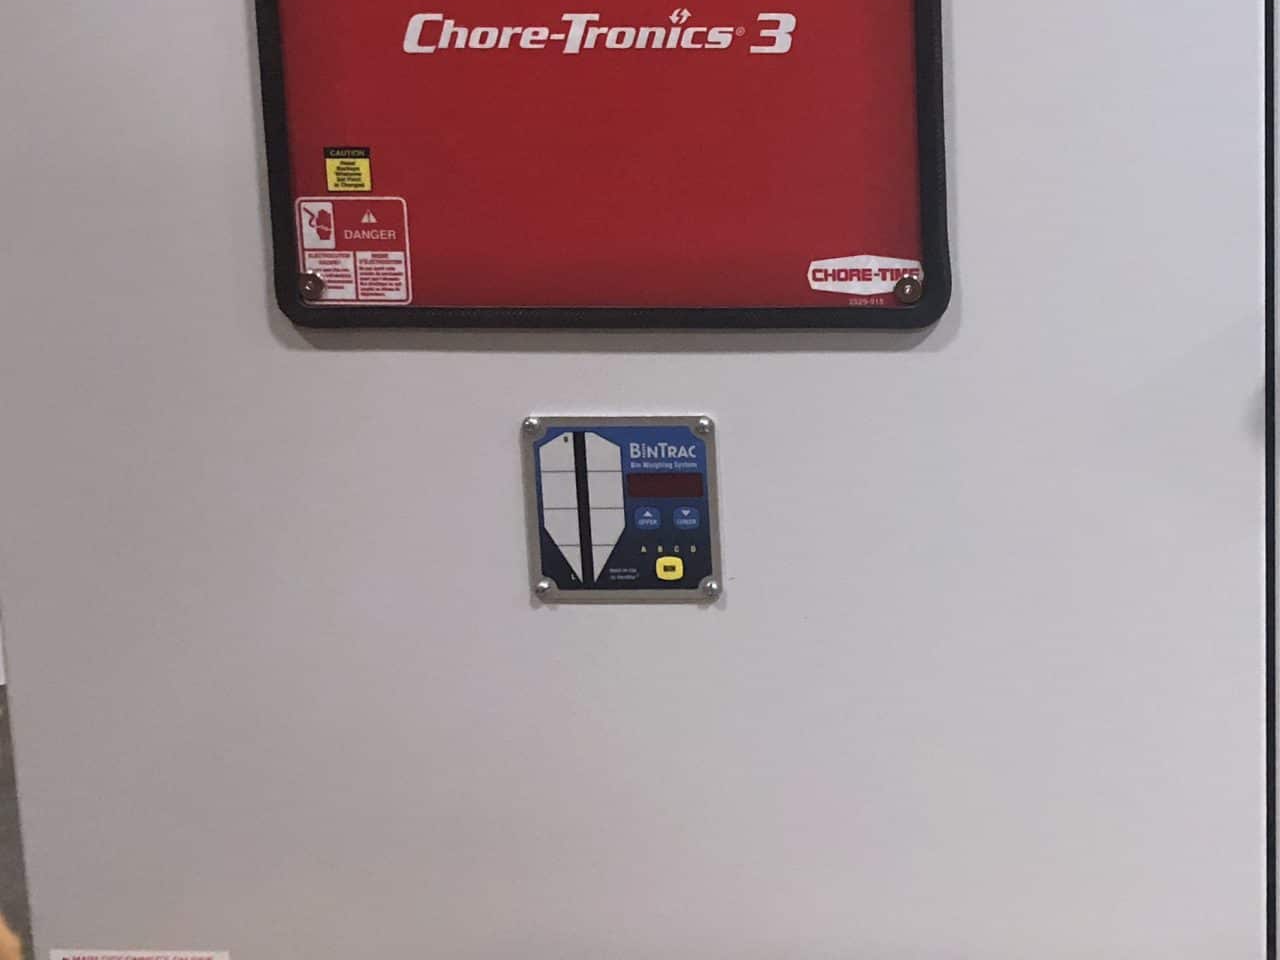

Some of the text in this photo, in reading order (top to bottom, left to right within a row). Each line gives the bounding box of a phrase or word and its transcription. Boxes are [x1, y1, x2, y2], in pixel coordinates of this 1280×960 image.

[402, 8, 797, 54] Chore-Tronics 3
[344, 230, 396, 239] DANGER
